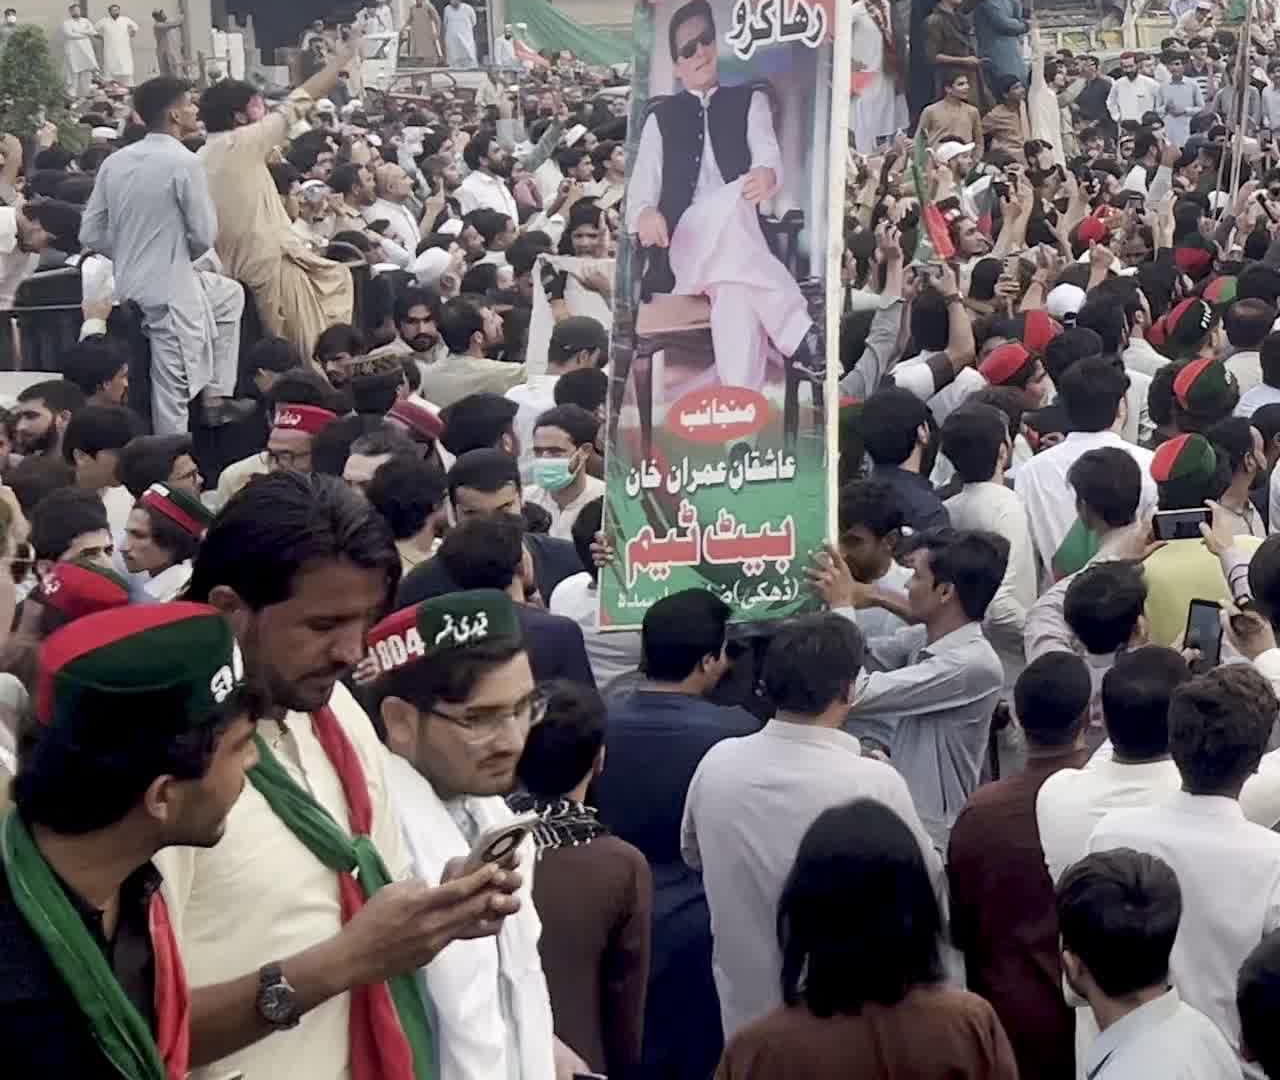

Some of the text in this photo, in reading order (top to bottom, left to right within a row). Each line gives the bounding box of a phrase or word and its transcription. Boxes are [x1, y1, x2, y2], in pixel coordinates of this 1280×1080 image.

[679, 397, 757, 432] منجانب
[625, 448, 797, 496] عاشقان عمران خان
